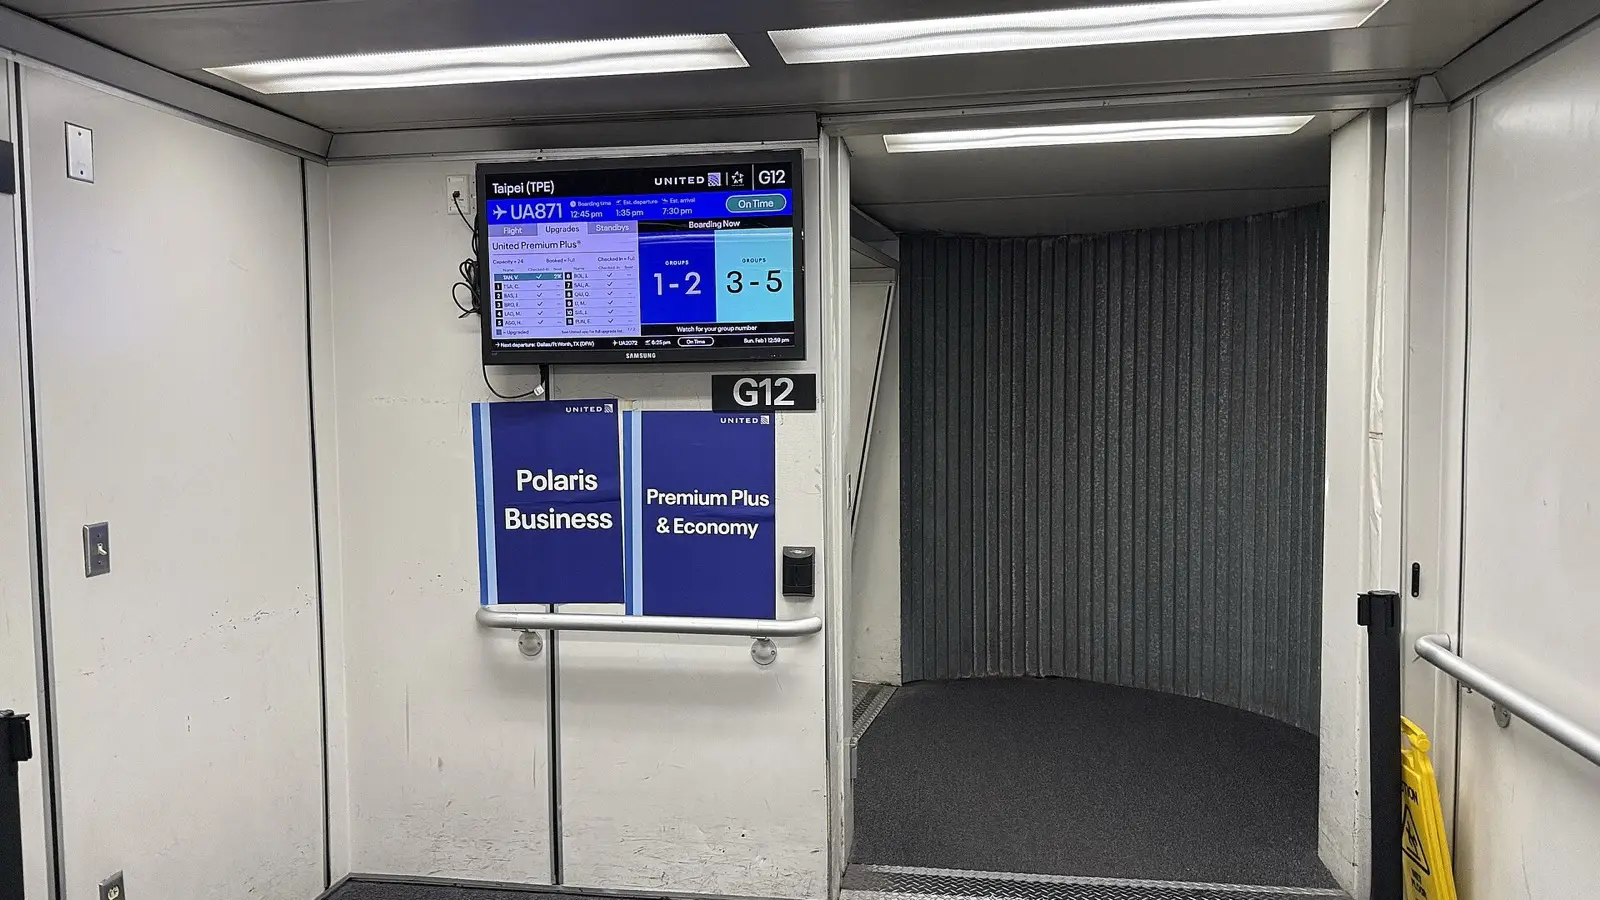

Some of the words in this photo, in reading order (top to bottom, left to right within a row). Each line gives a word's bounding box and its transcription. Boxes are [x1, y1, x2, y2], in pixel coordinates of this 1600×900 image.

[654, 176, 705, 186] UNITED
[758, 169, 786, 184] G12
[492, 183, 524, 196] Taipei
[526, 180, 555, 195] (TPE)
[635, 198, 658, 206] departure
[738, 200, 751, 209] On
[752, 198, 774, 208] Time
[510, 202, 562, 220] UA871
[570, 210, 590, 219] 12:45
[616, 208, 630, 217] 1:35
[631, 209, 644, 217] pm
[662, 207, 679, 215] 7:30
[680, 208, 693, 216] pm
[595, 224, 630, 232] Standbys
[688, 220, 722, 229] Boarding
[722, 219, 741, 228] Now
[503, 226, 523, 235] Flight
[545, 226, 580, 234] Upgrades
[492, 242, 520, 251] United
[521, 240, 559, 250] Premium
[732, 377, 795, 407] G12
[720, 417, 759, 425] UNITED
[516, 469, 598, 491] Polaris
[646, 488, 728, 506] Premium
[731, 489, 770, 507] Plus
[504, 508, 613, 530] Business
[656, 518, 670, 534] &
[673, 517, 759, 540] Economy
